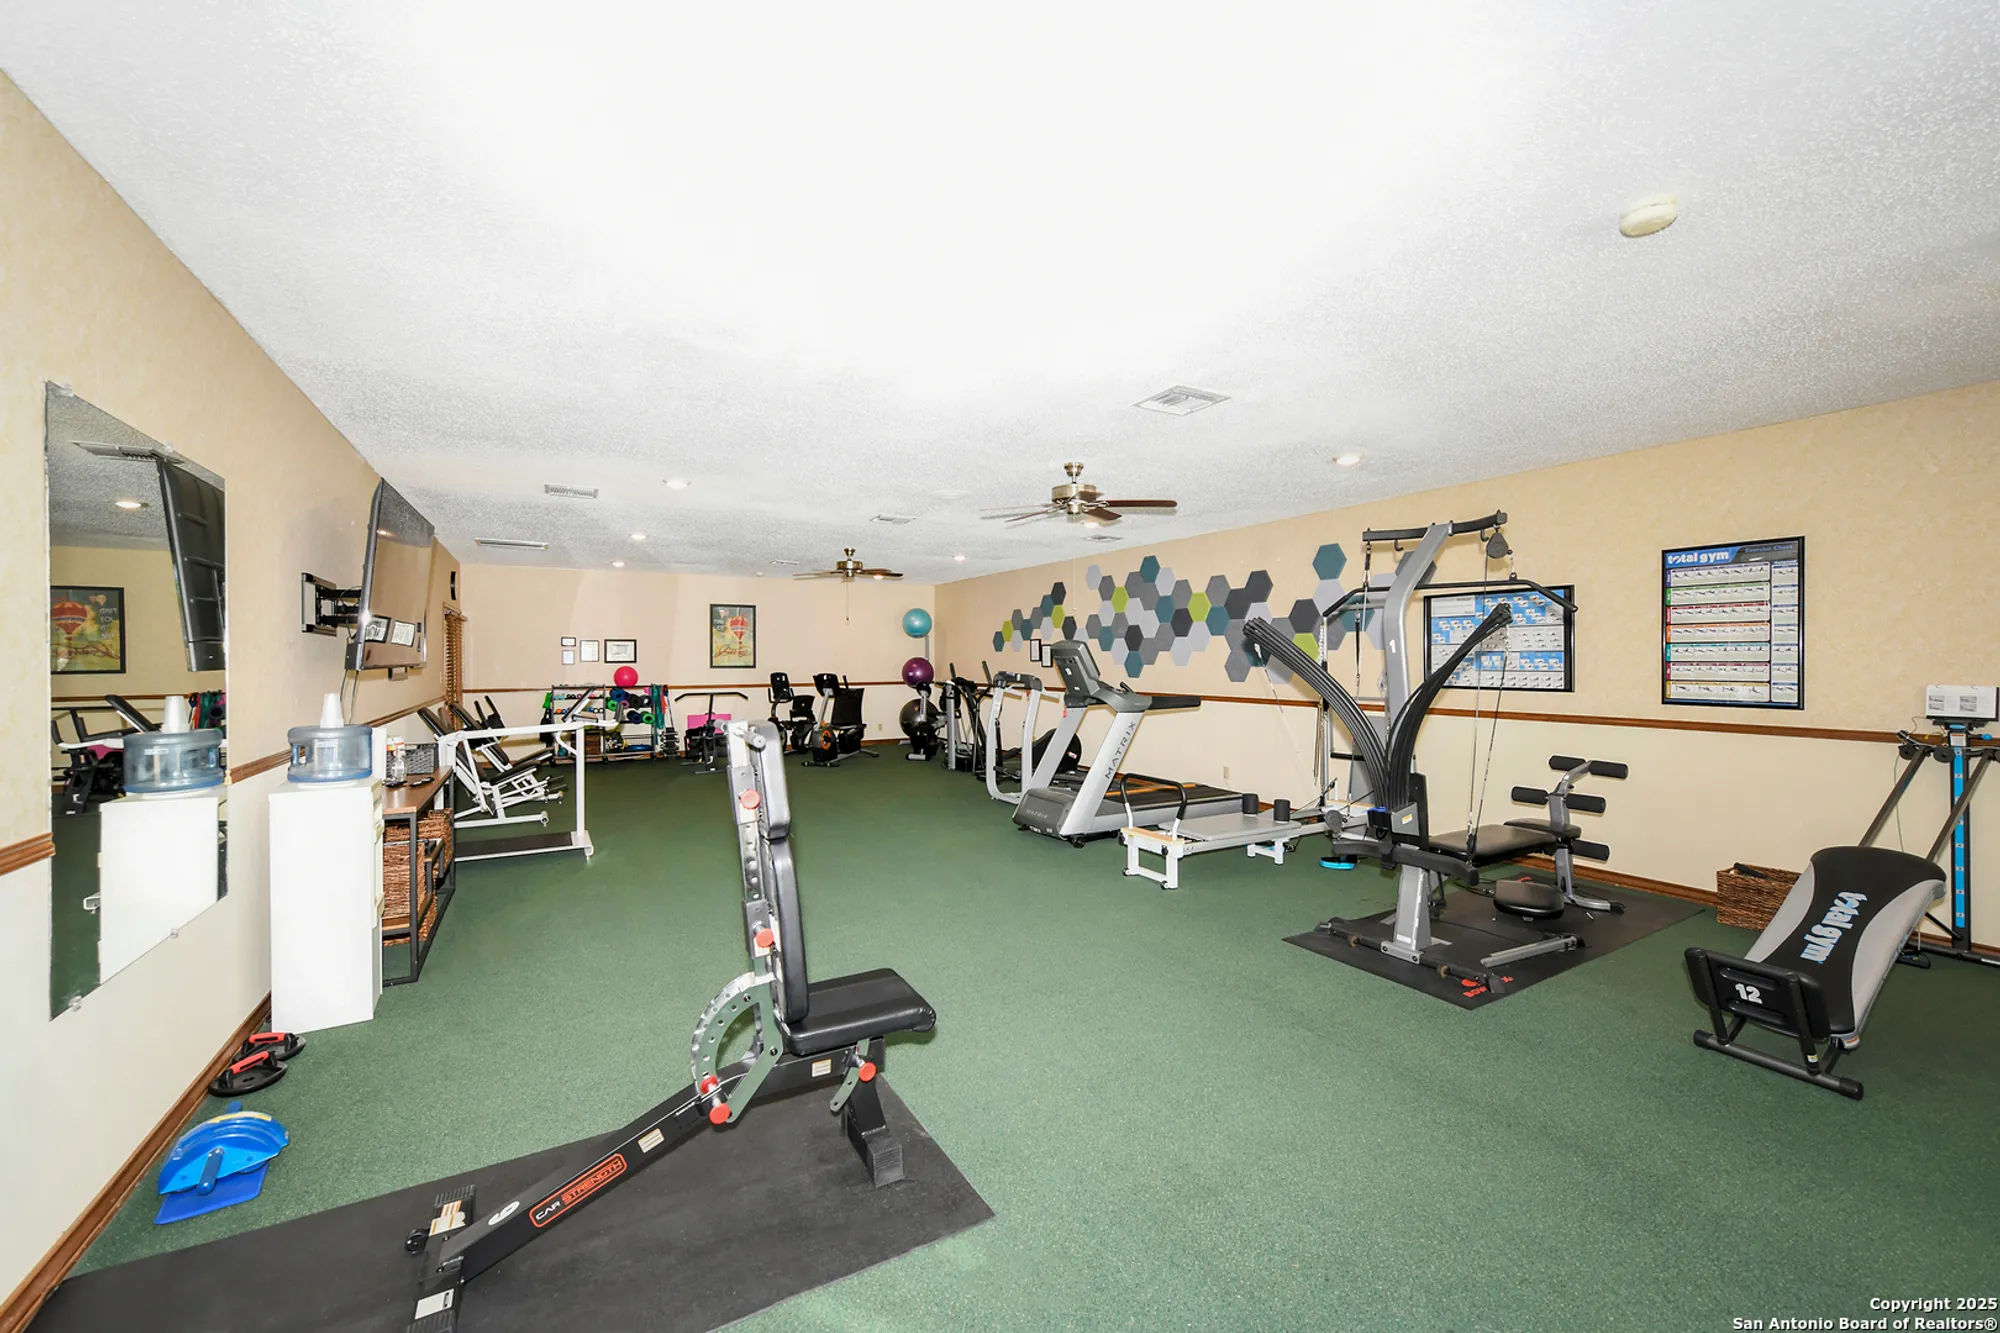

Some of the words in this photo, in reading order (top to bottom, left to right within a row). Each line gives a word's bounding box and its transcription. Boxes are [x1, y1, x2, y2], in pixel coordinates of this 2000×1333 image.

[1667, 552, 1698, 565] total
[1699, 551, 1730, 563] gym
[1104, 721, 1136, 779] MATRIX
[1025, 809, 1049, 819] MATRIX
[1800, 924, 1842, 962] gym
[1734, 982, 1763, 1005] 12
[535, 1201, 561, 1220] CAR
[561, 1158, 624, 1205] STRENGTH
